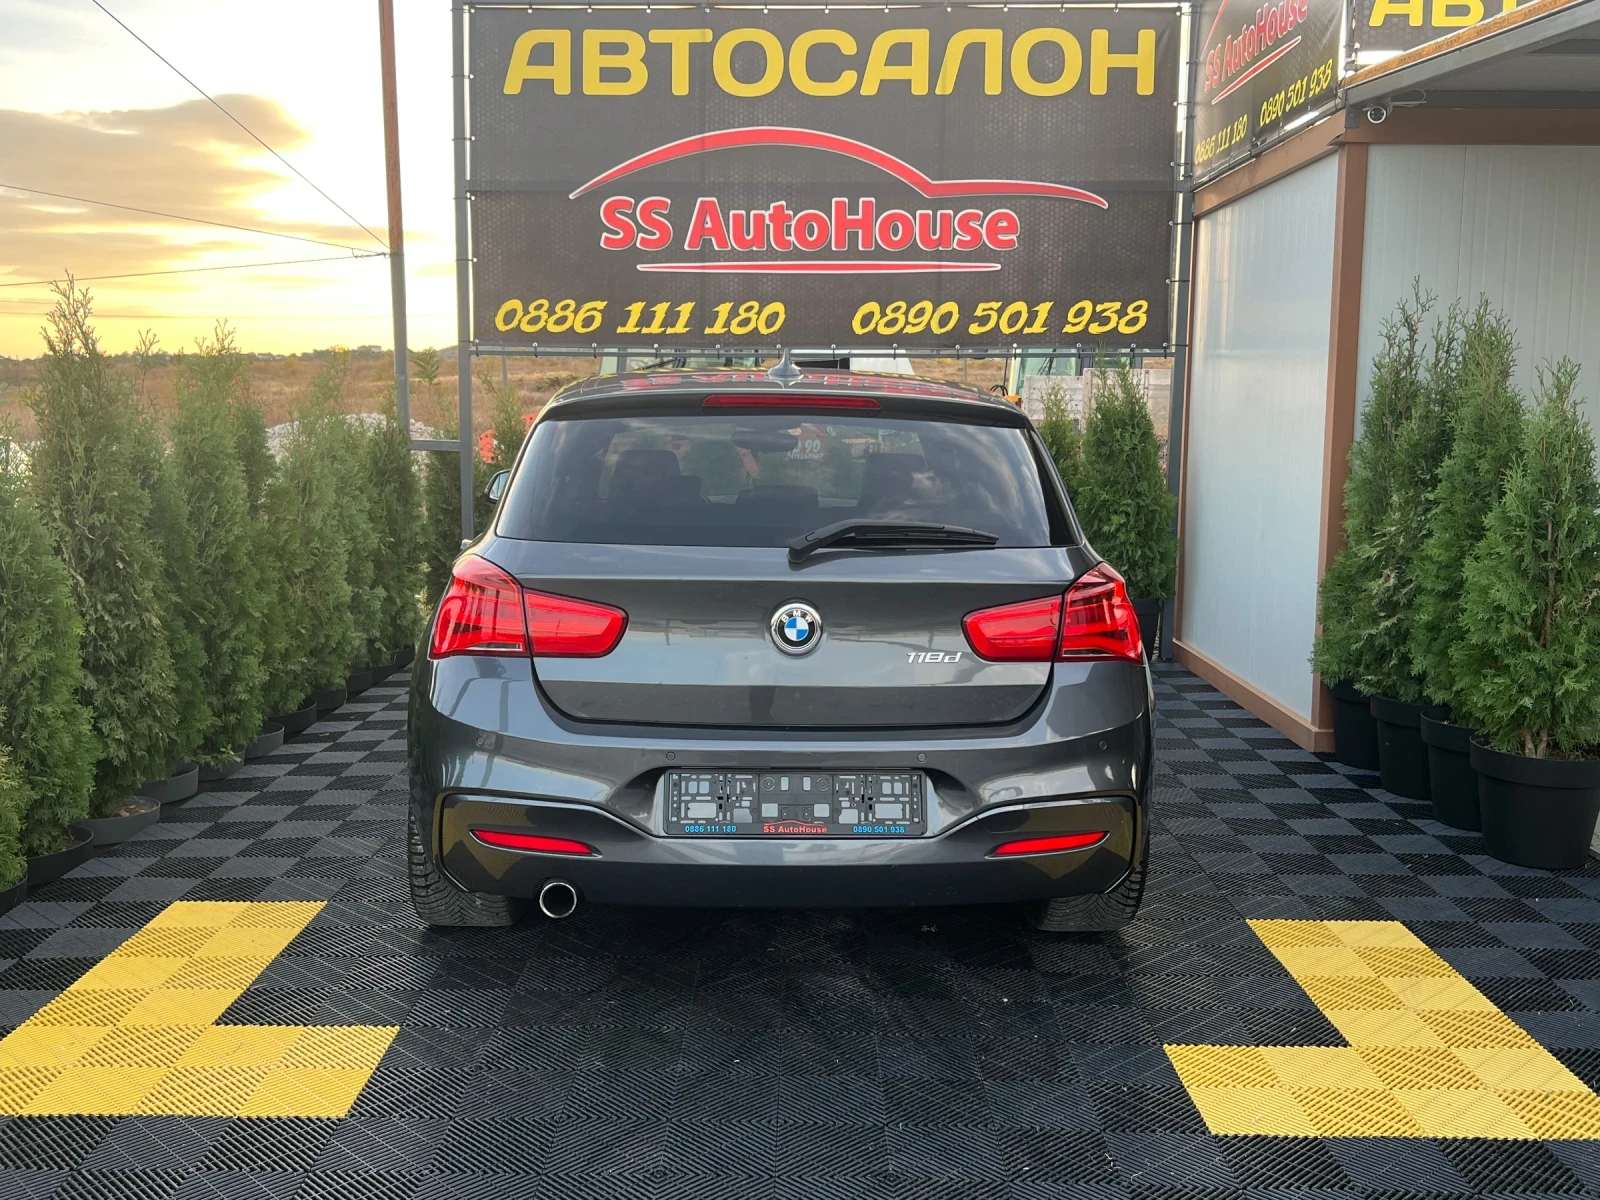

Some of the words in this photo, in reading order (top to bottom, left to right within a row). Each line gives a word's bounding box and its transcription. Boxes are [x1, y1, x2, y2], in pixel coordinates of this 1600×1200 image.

[503, 27, 1157, 97] АВТОСАЛОН
[1204, 44, 1222, 93] SS
[1222, 0, 1308, 82] AutoHouse
[1259, 90, 1286, 127] 0890
[1285, 76, 1309, 113] 501
[1309, 58, 1333, 99] 938
[1194, 136, 1215, 165] 0886
[1216, 128, 1231, 154] 111
[1231, 114, 1248, 146] 180
[599, 196, 673, 251] SS
[685, 196, 1020, 252] AutoHouse
[494, 298, 608, 335] 0886
[616, 299, 697, 336] 111
[704, 300, 787, 336] 180
[851, 299, 960, 336] 0890
[968, 299, 1055, 336] 501
[1062, 298, 1150, 337] 938
[779, 609, 814, 623] BMW
[907, 651, 962, 664] 118d
[685, 825, 705, 833] 0886
[706, 825, 719, 833] 111
[722, 825, 737, 833] 180
[763, 825, 776, 833] SS
[778, 825, 828, 833] AutoHouse
[853, 825, 872, 833] 0890
[874, 825, 888, 833] 501
[890, 825, 905, 833] 938
